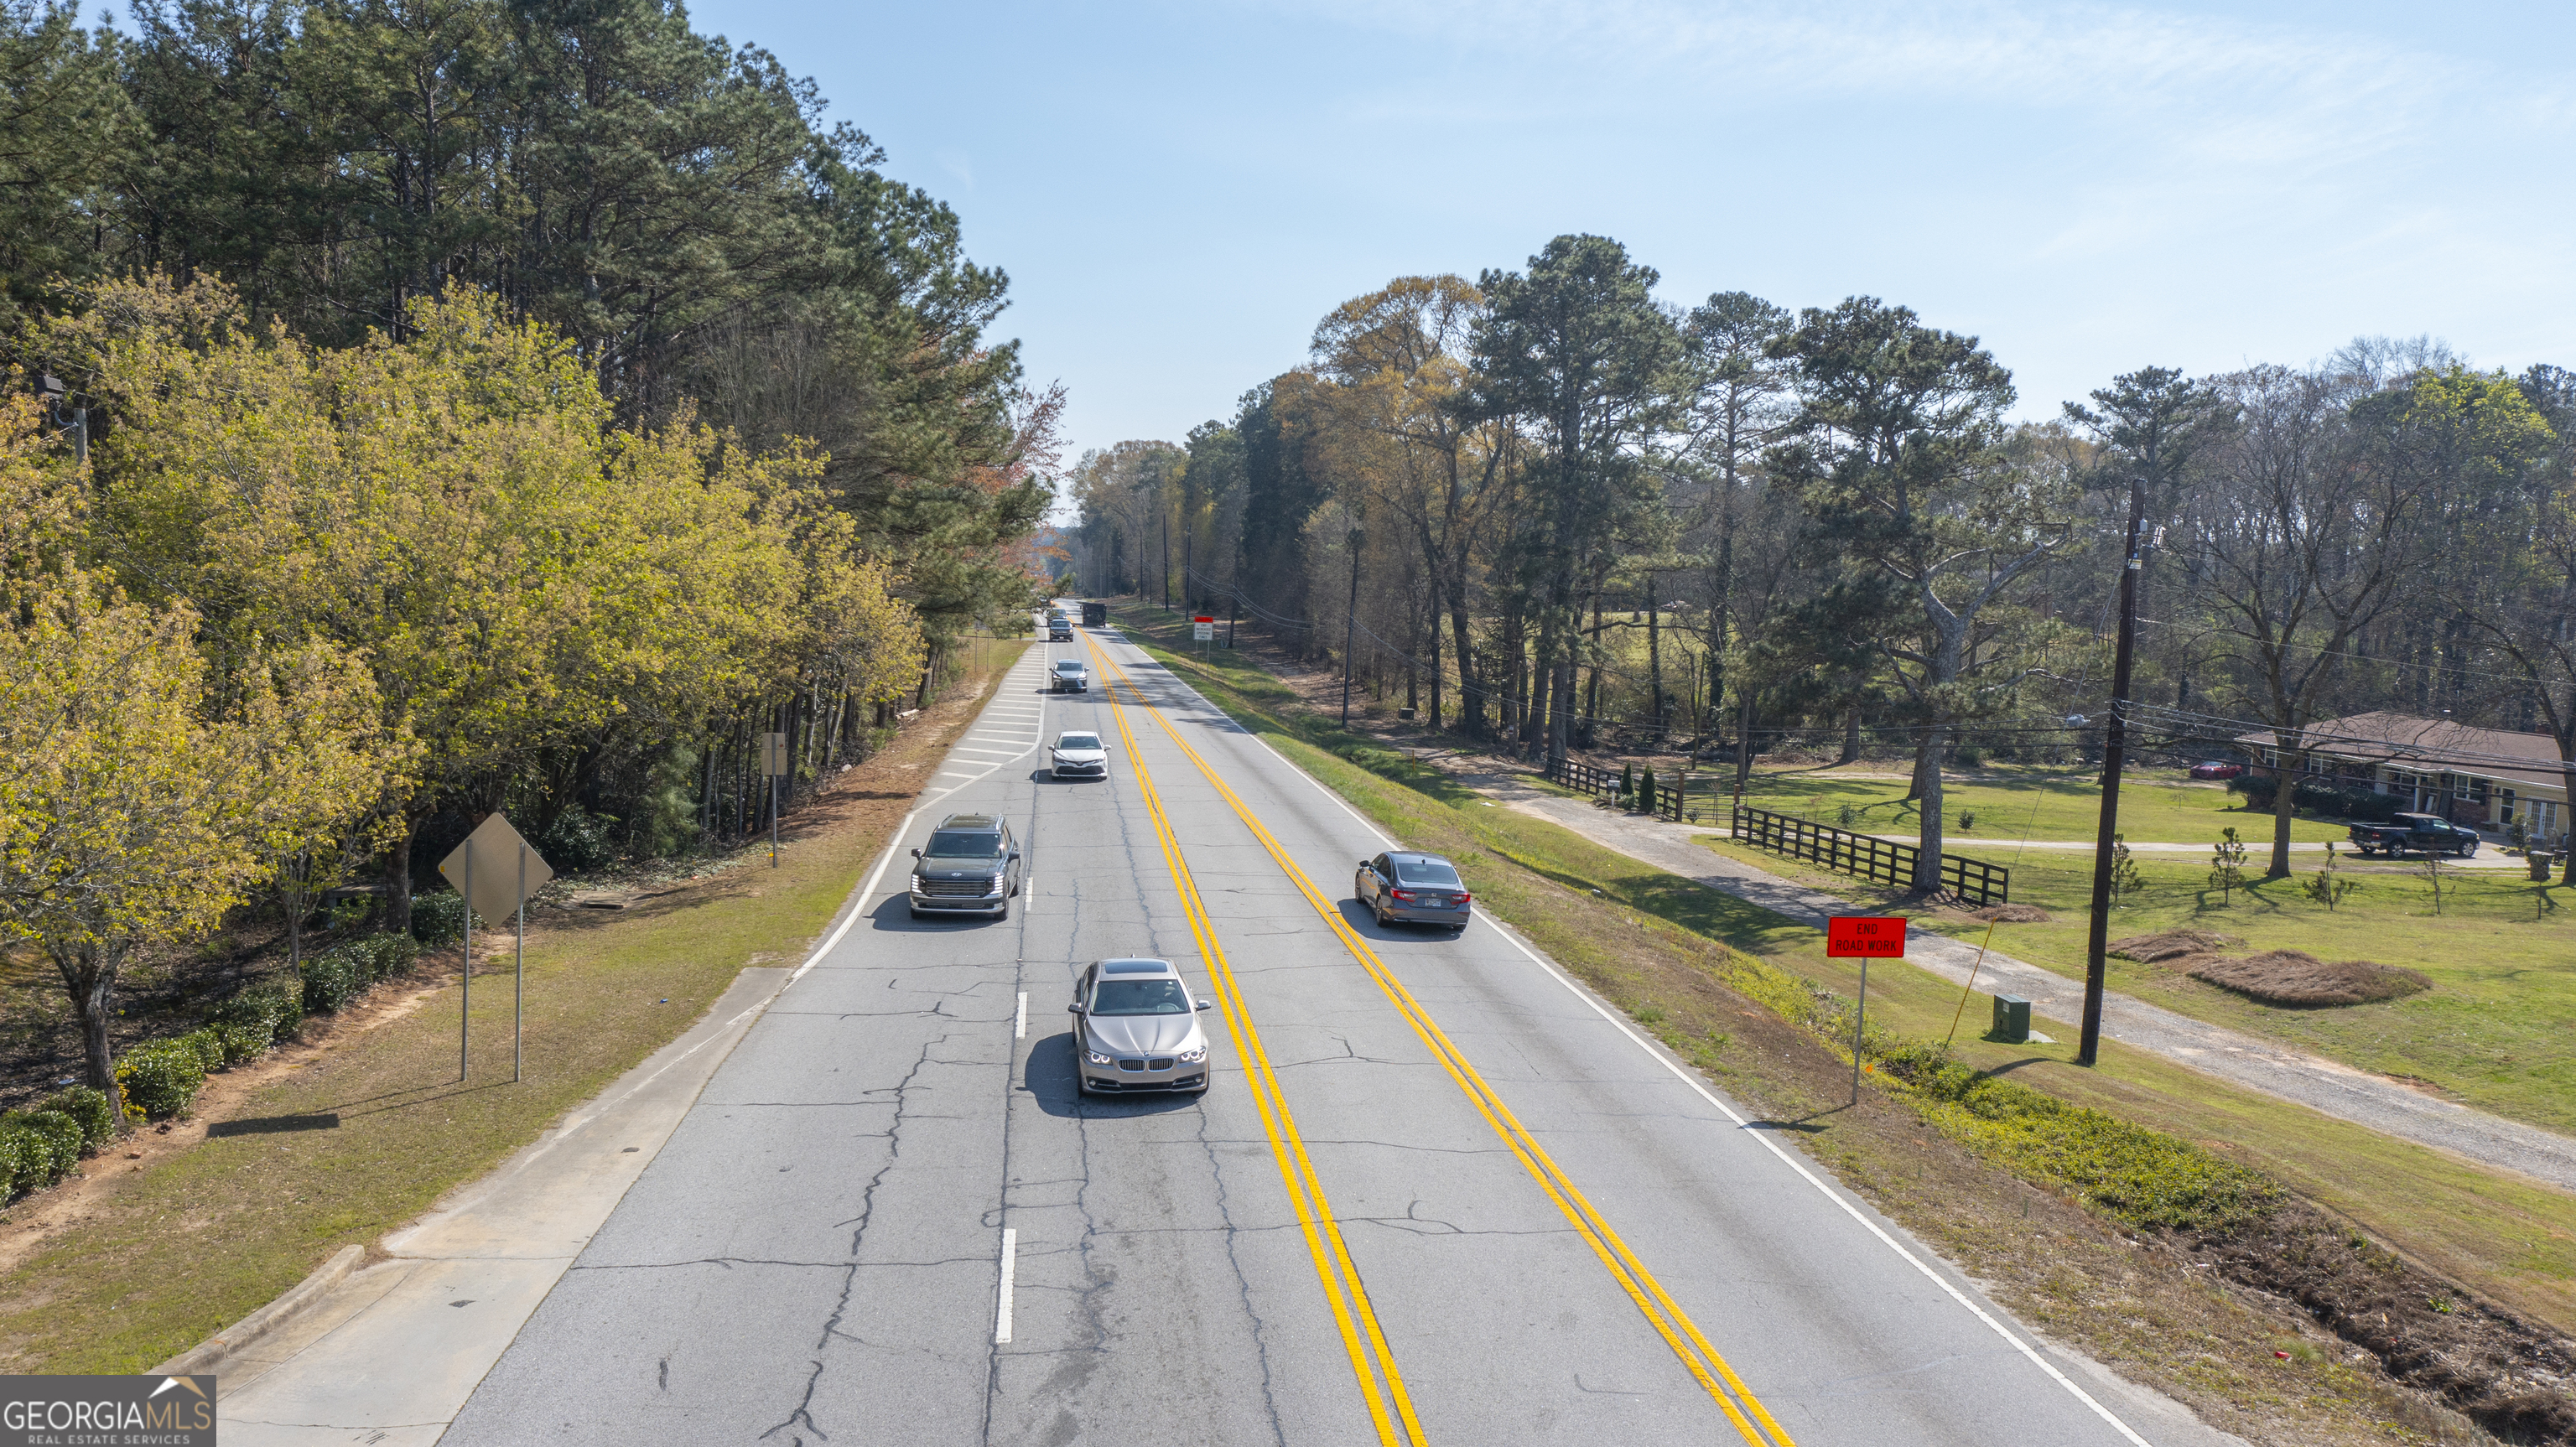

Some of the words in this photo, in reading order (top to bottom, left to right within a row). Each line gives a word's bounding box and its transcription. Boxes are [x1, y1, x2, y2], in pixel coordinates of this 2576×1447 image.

[1857, 924, 1877, 935] END
[1836, 940, 1863, 951] ROAD
[1868, 940, 1897, 952] WORK
